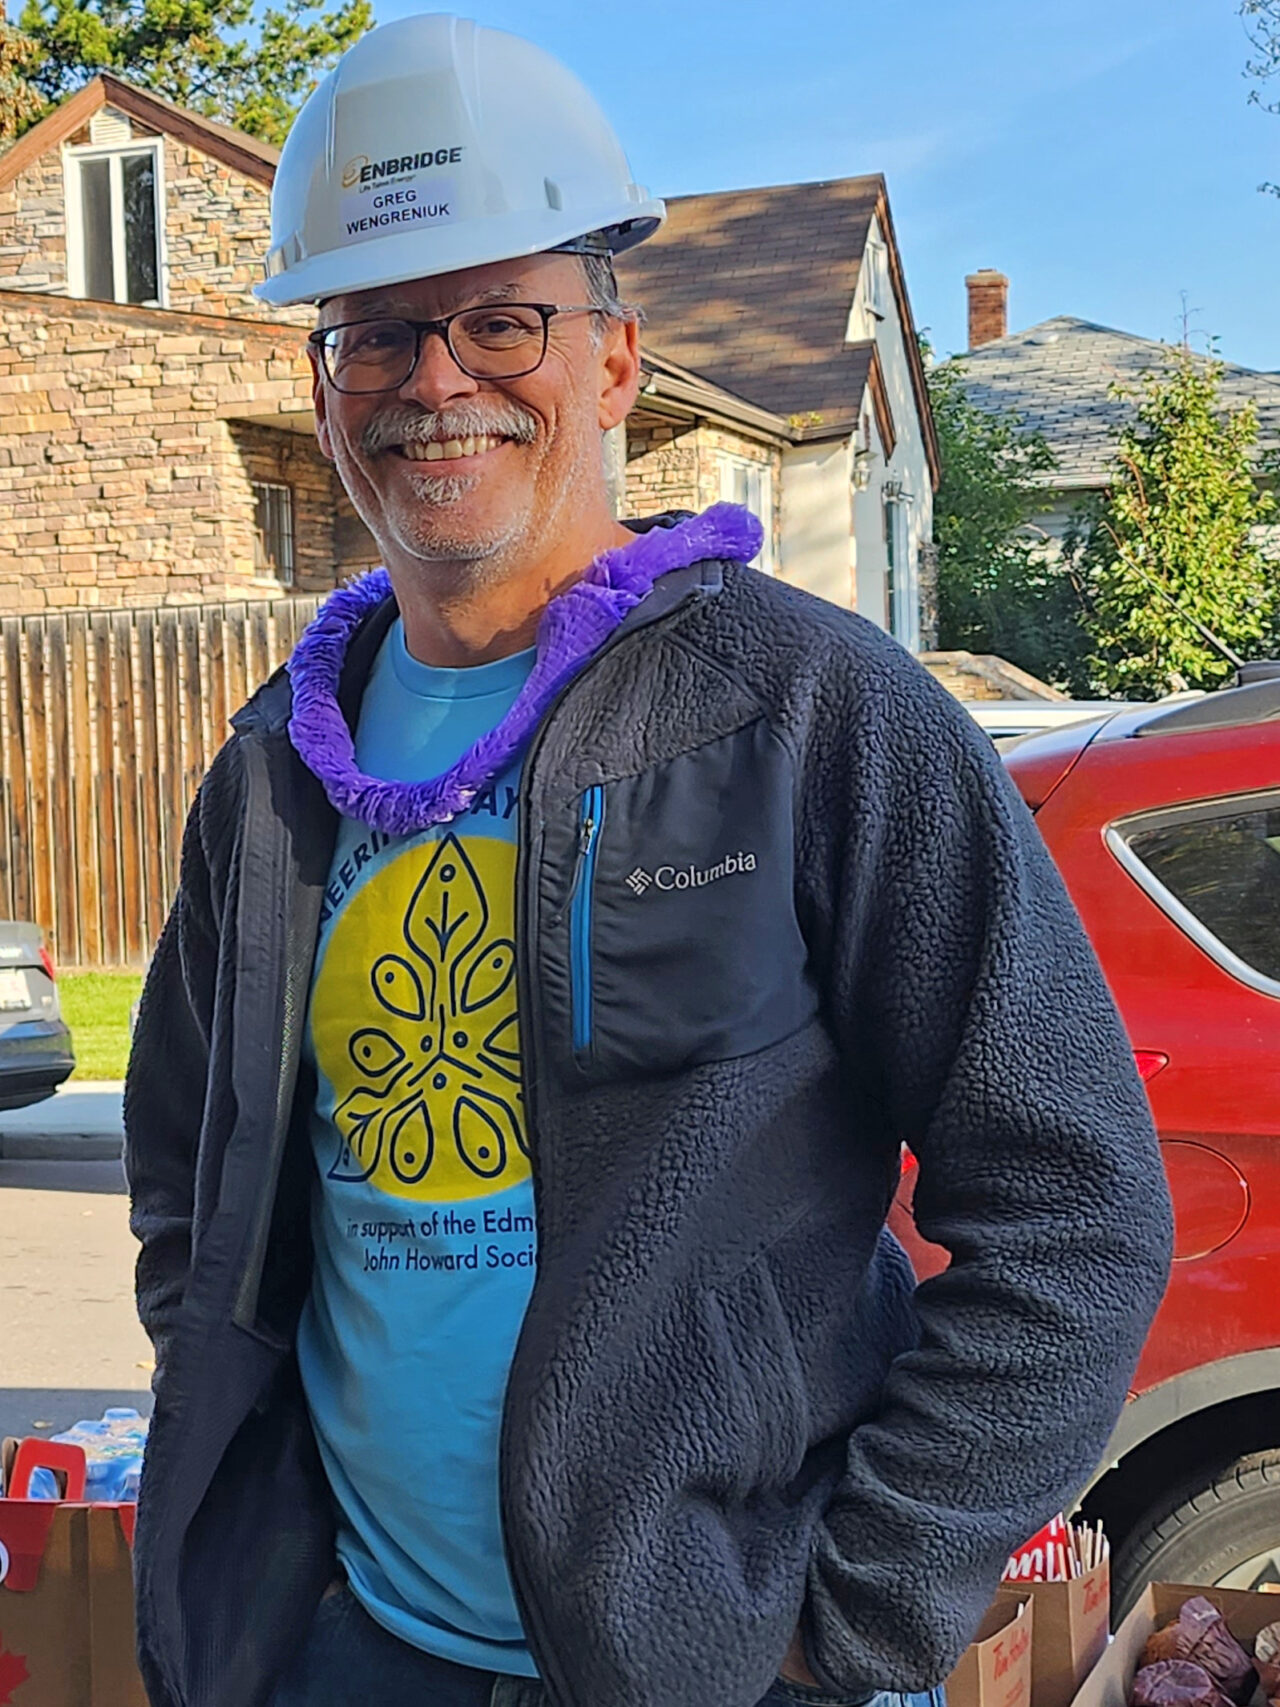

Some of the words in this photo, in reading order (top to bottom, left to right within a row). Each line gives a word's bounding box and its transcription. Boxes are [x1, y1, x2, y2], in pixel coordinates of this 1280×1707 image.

[360, 147, 462, 183] ENBRIDGE
[373, 190, 417, 208] GREG
[346, 203, 450, 235] WENGRENIUK
[470, 783, 519, 821] AY
[654, 851, 756, 890] Columbia
[347, 1217, 357, 1239] in
[421, 1210, 439, 1238] of
[443, 1210, 476, 1235] the
[483, 1207, 534, 1234] Edm
[363, 1247, 400, 1272] John
[405, 1245, 478, 1271] Howard
[486, 1244, 534, 1269] Soci
